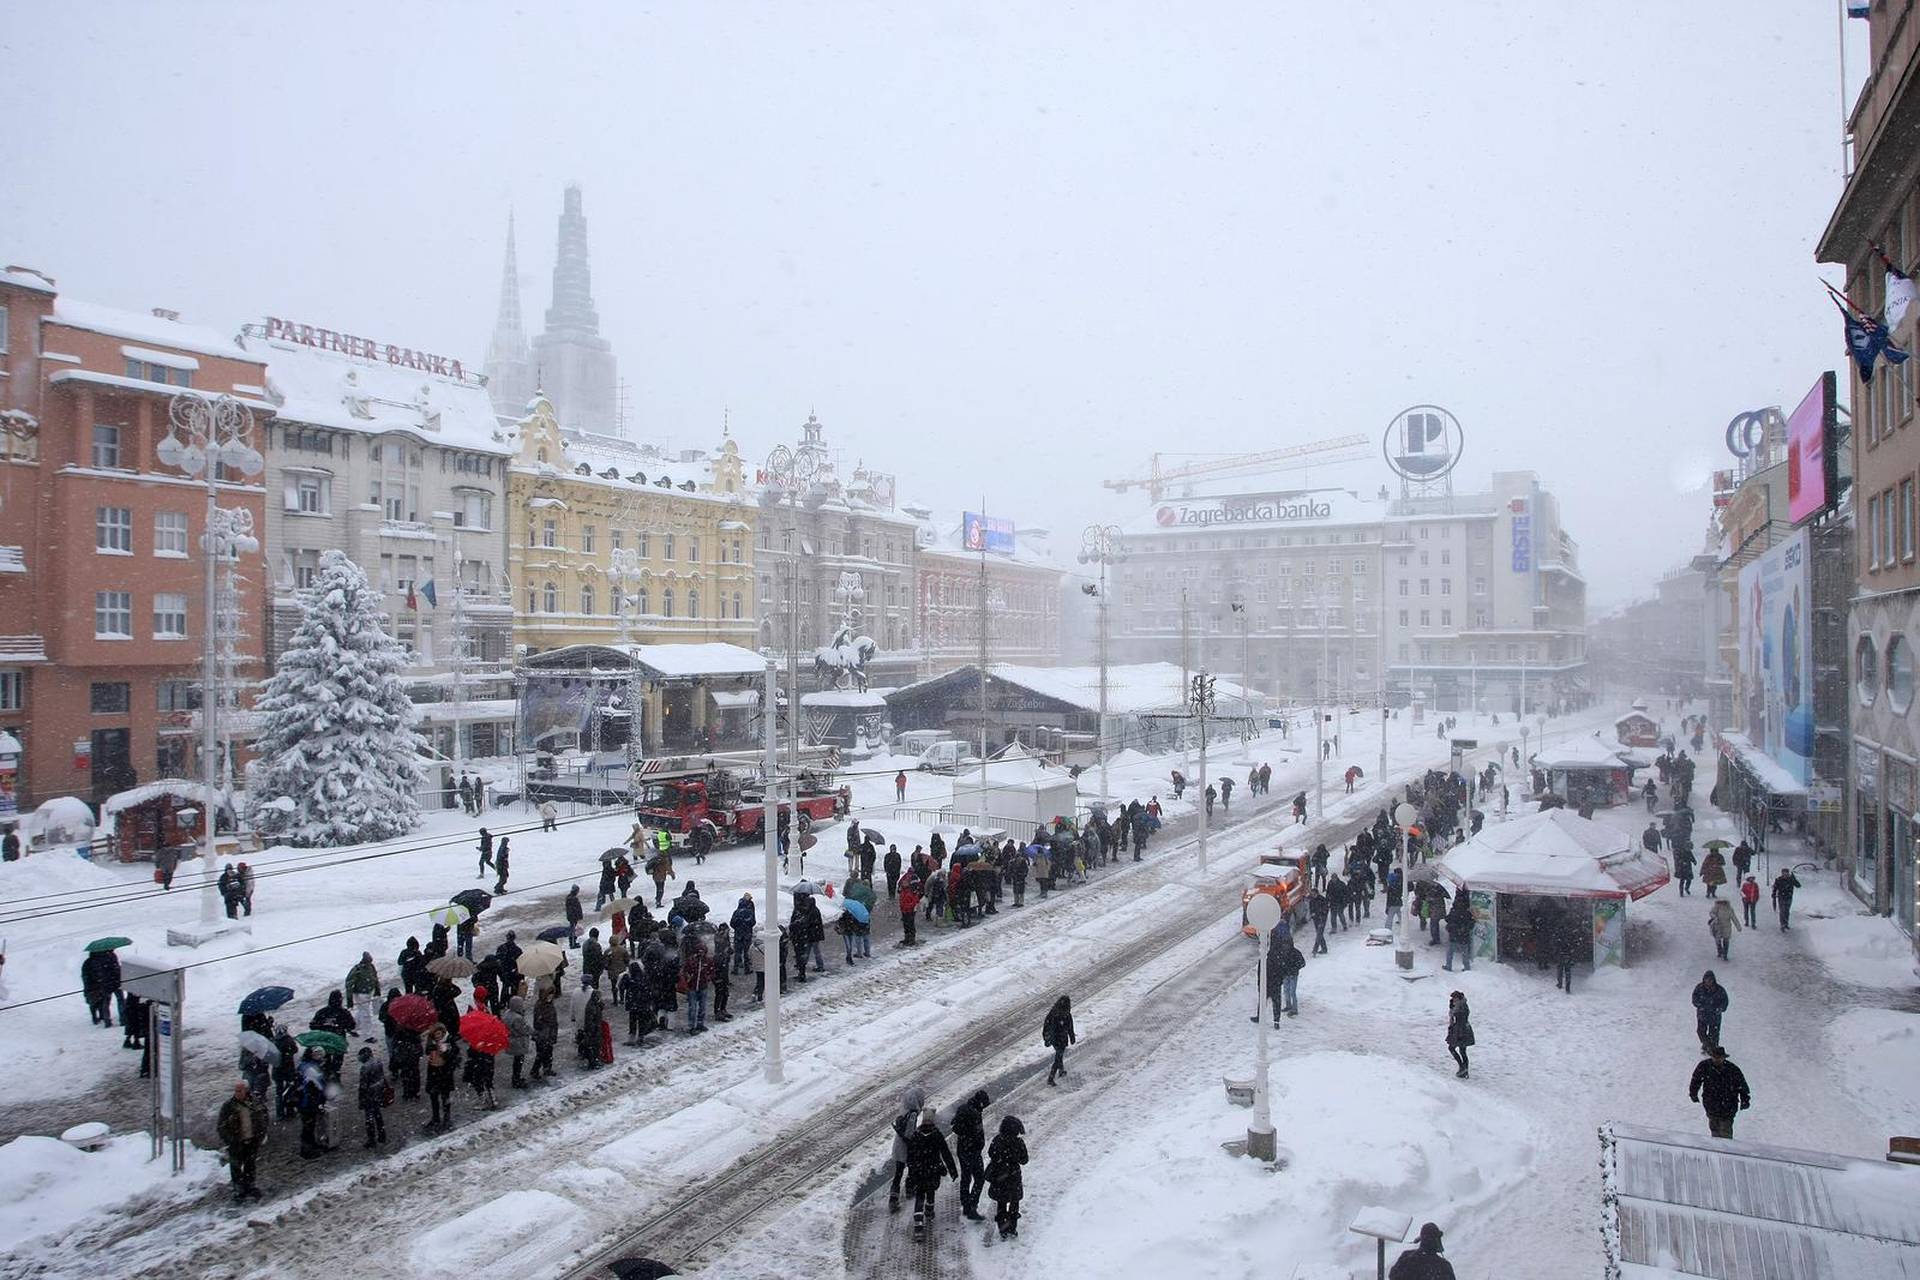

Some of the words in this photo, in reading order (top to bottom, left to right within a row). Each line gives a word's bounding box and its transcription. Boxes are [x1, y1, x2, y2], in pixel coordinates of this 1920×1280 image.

[265, 316, 377, 361] PARTNER
[385, 344, 465, 380] BANKA
[1276, 498, 1331, 519] banka
[1511, 516, 1530, 573] ERSTE
